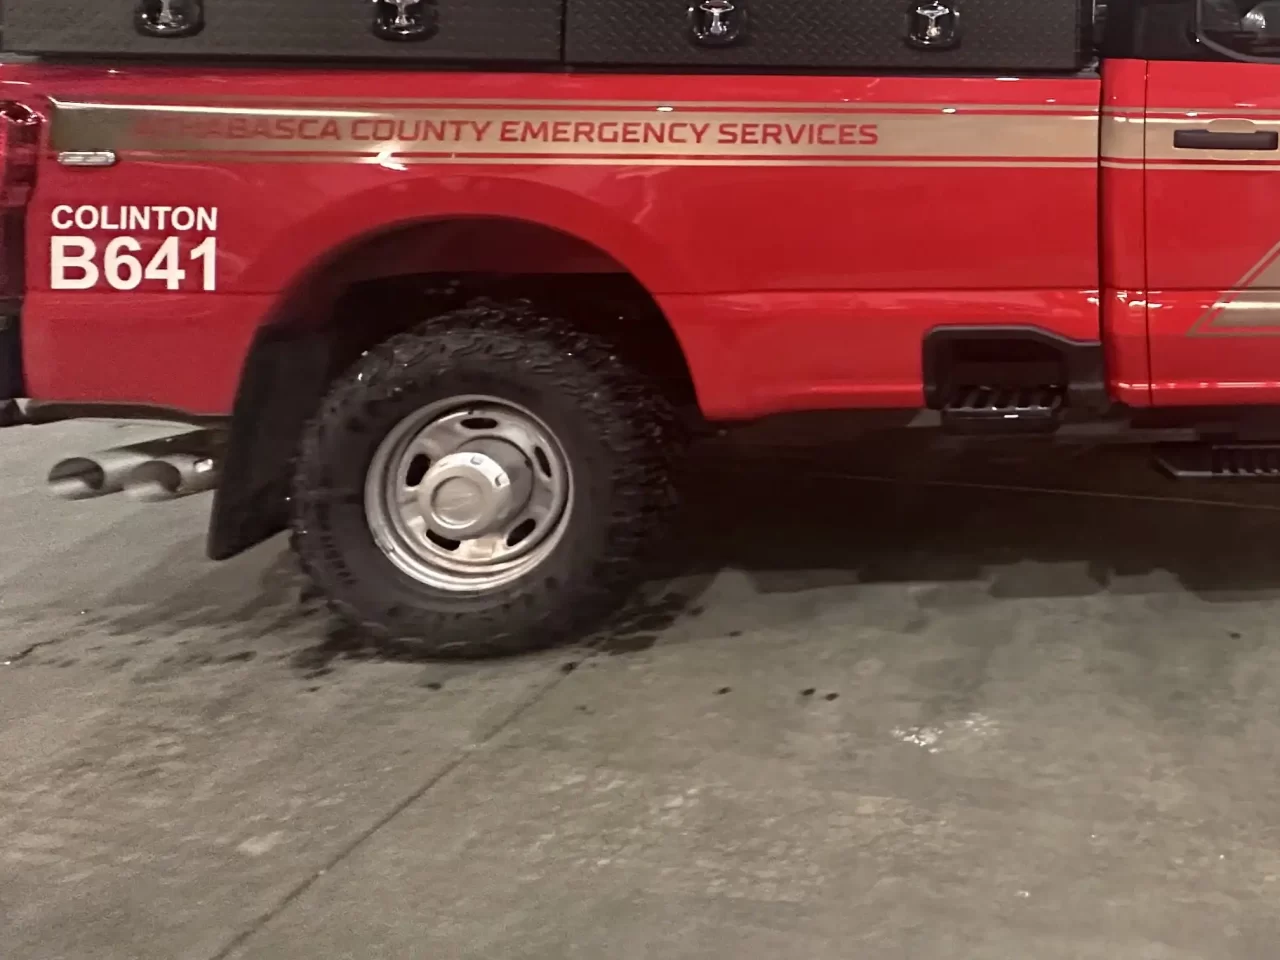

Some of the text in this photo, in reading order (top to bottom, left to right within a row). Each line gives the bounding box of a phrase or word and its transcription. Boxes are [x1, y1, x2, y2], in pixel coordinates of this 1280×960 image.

[350, 118, 493, 143] COUNTY
[500, 120, 710, 144] EMERGENCY
[717, 122, 879, 146] SERVICES
[50, 204, 218, 231] COLINTON
[50, 235, 217, 291] B641
